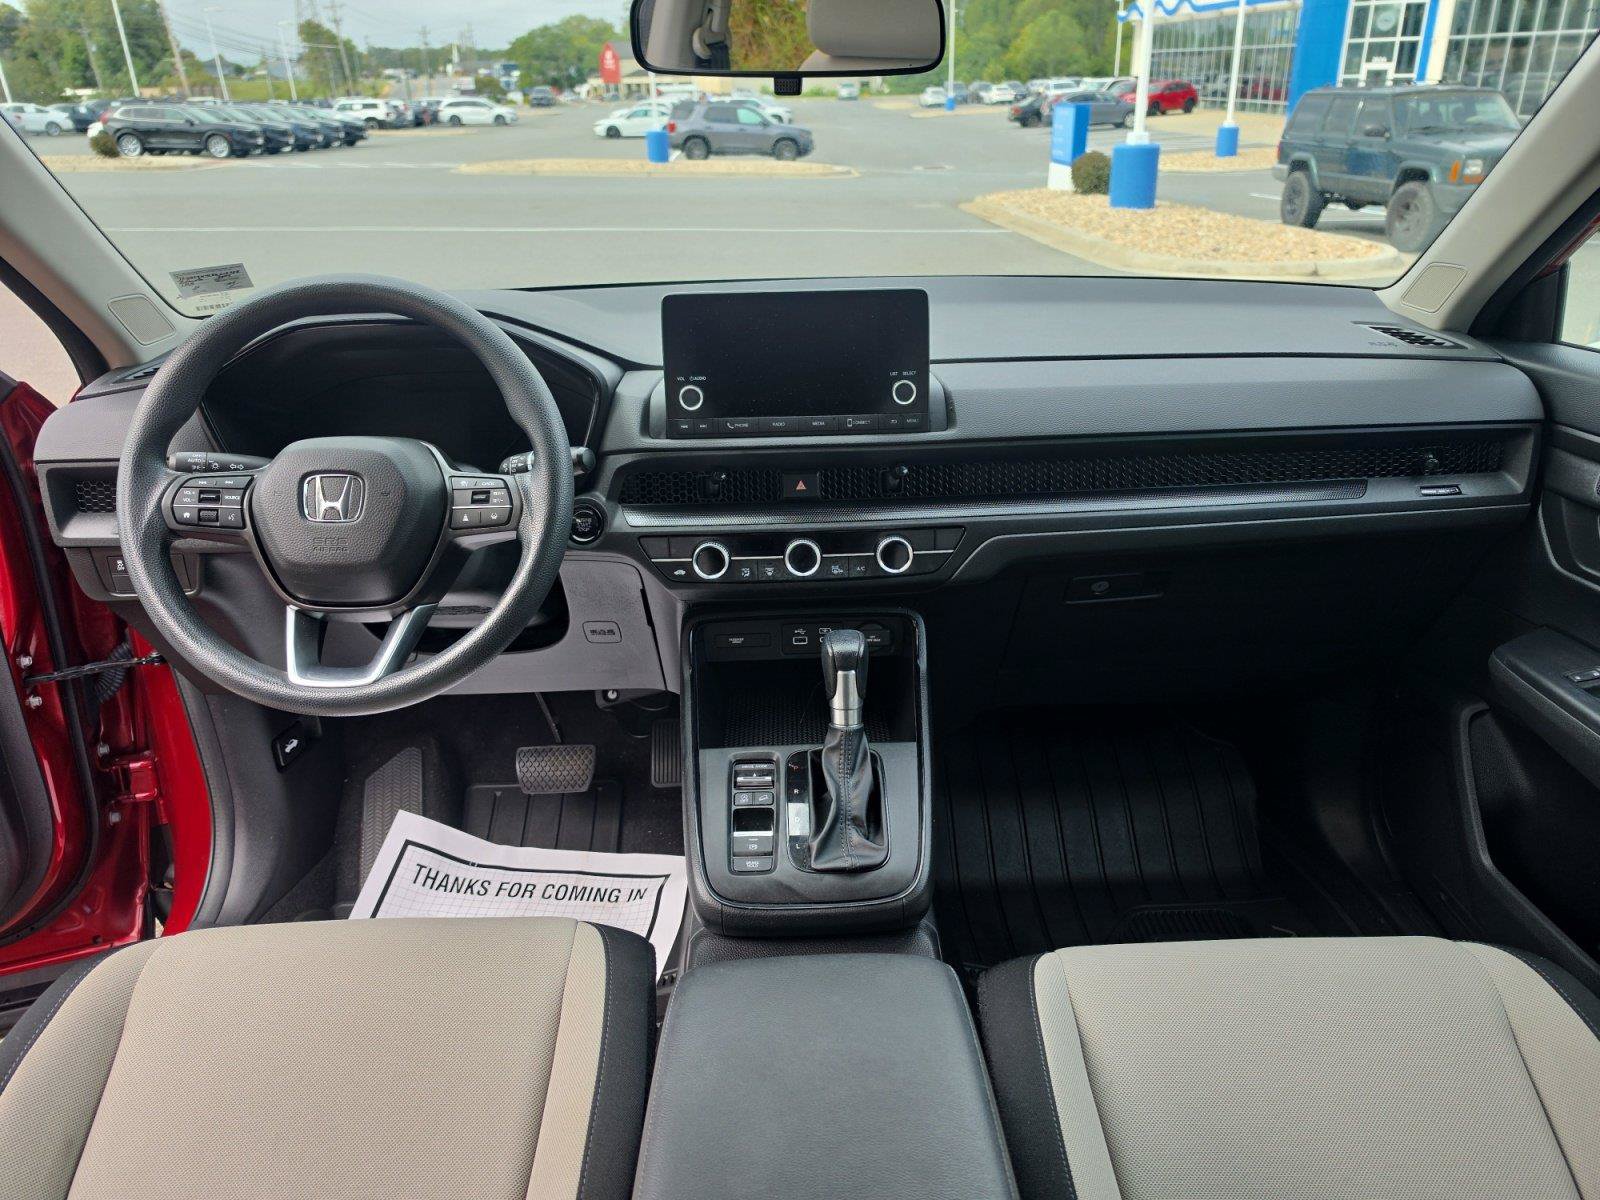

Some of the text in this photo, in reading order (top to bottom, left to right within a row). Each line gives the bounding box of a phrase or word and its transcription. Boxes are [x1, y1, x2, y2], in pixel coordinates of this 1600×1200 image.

[412, 863, 648, 903] THANKS FOR COMING IN
